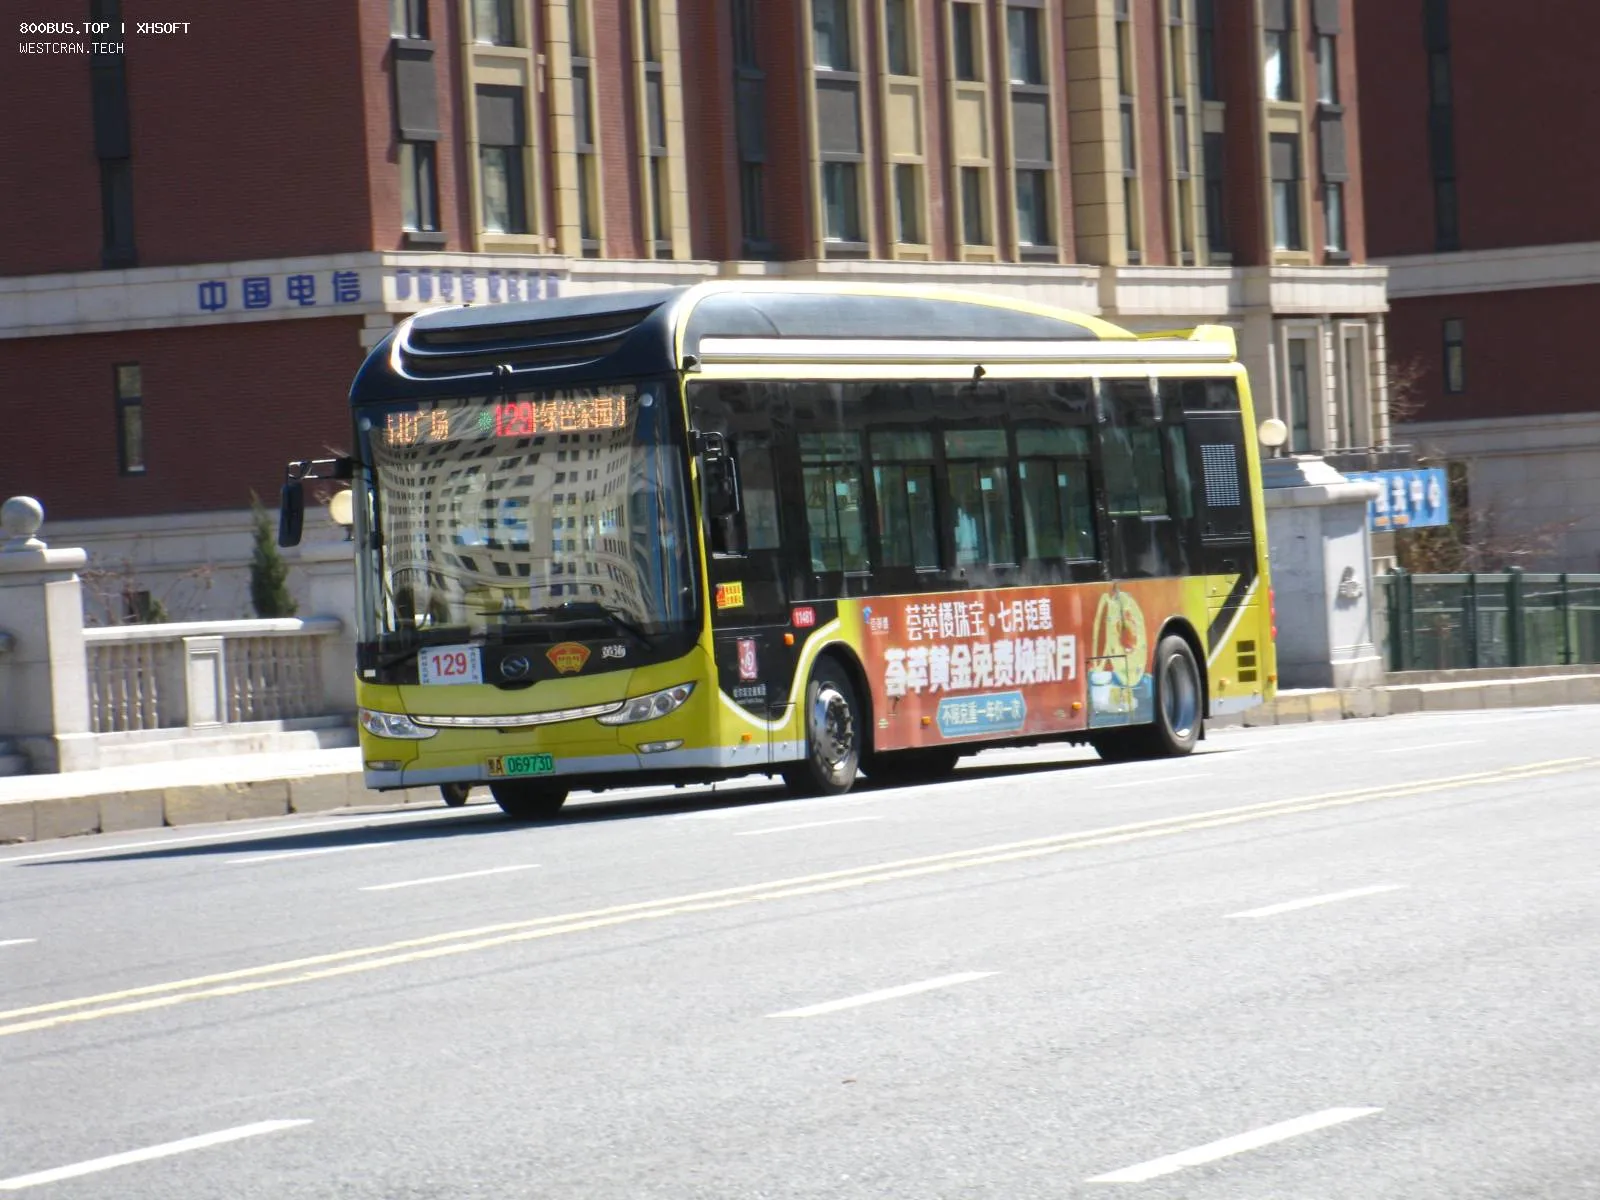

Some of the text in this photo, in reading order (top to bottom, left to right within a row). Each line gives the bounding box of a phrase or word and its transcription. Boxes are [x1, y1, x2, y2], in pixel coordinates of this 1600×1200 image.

[199, 270, 362, 312] 中国电信
[496, 401, 534, 436] 129
[432, 652, 467, 677] 129
